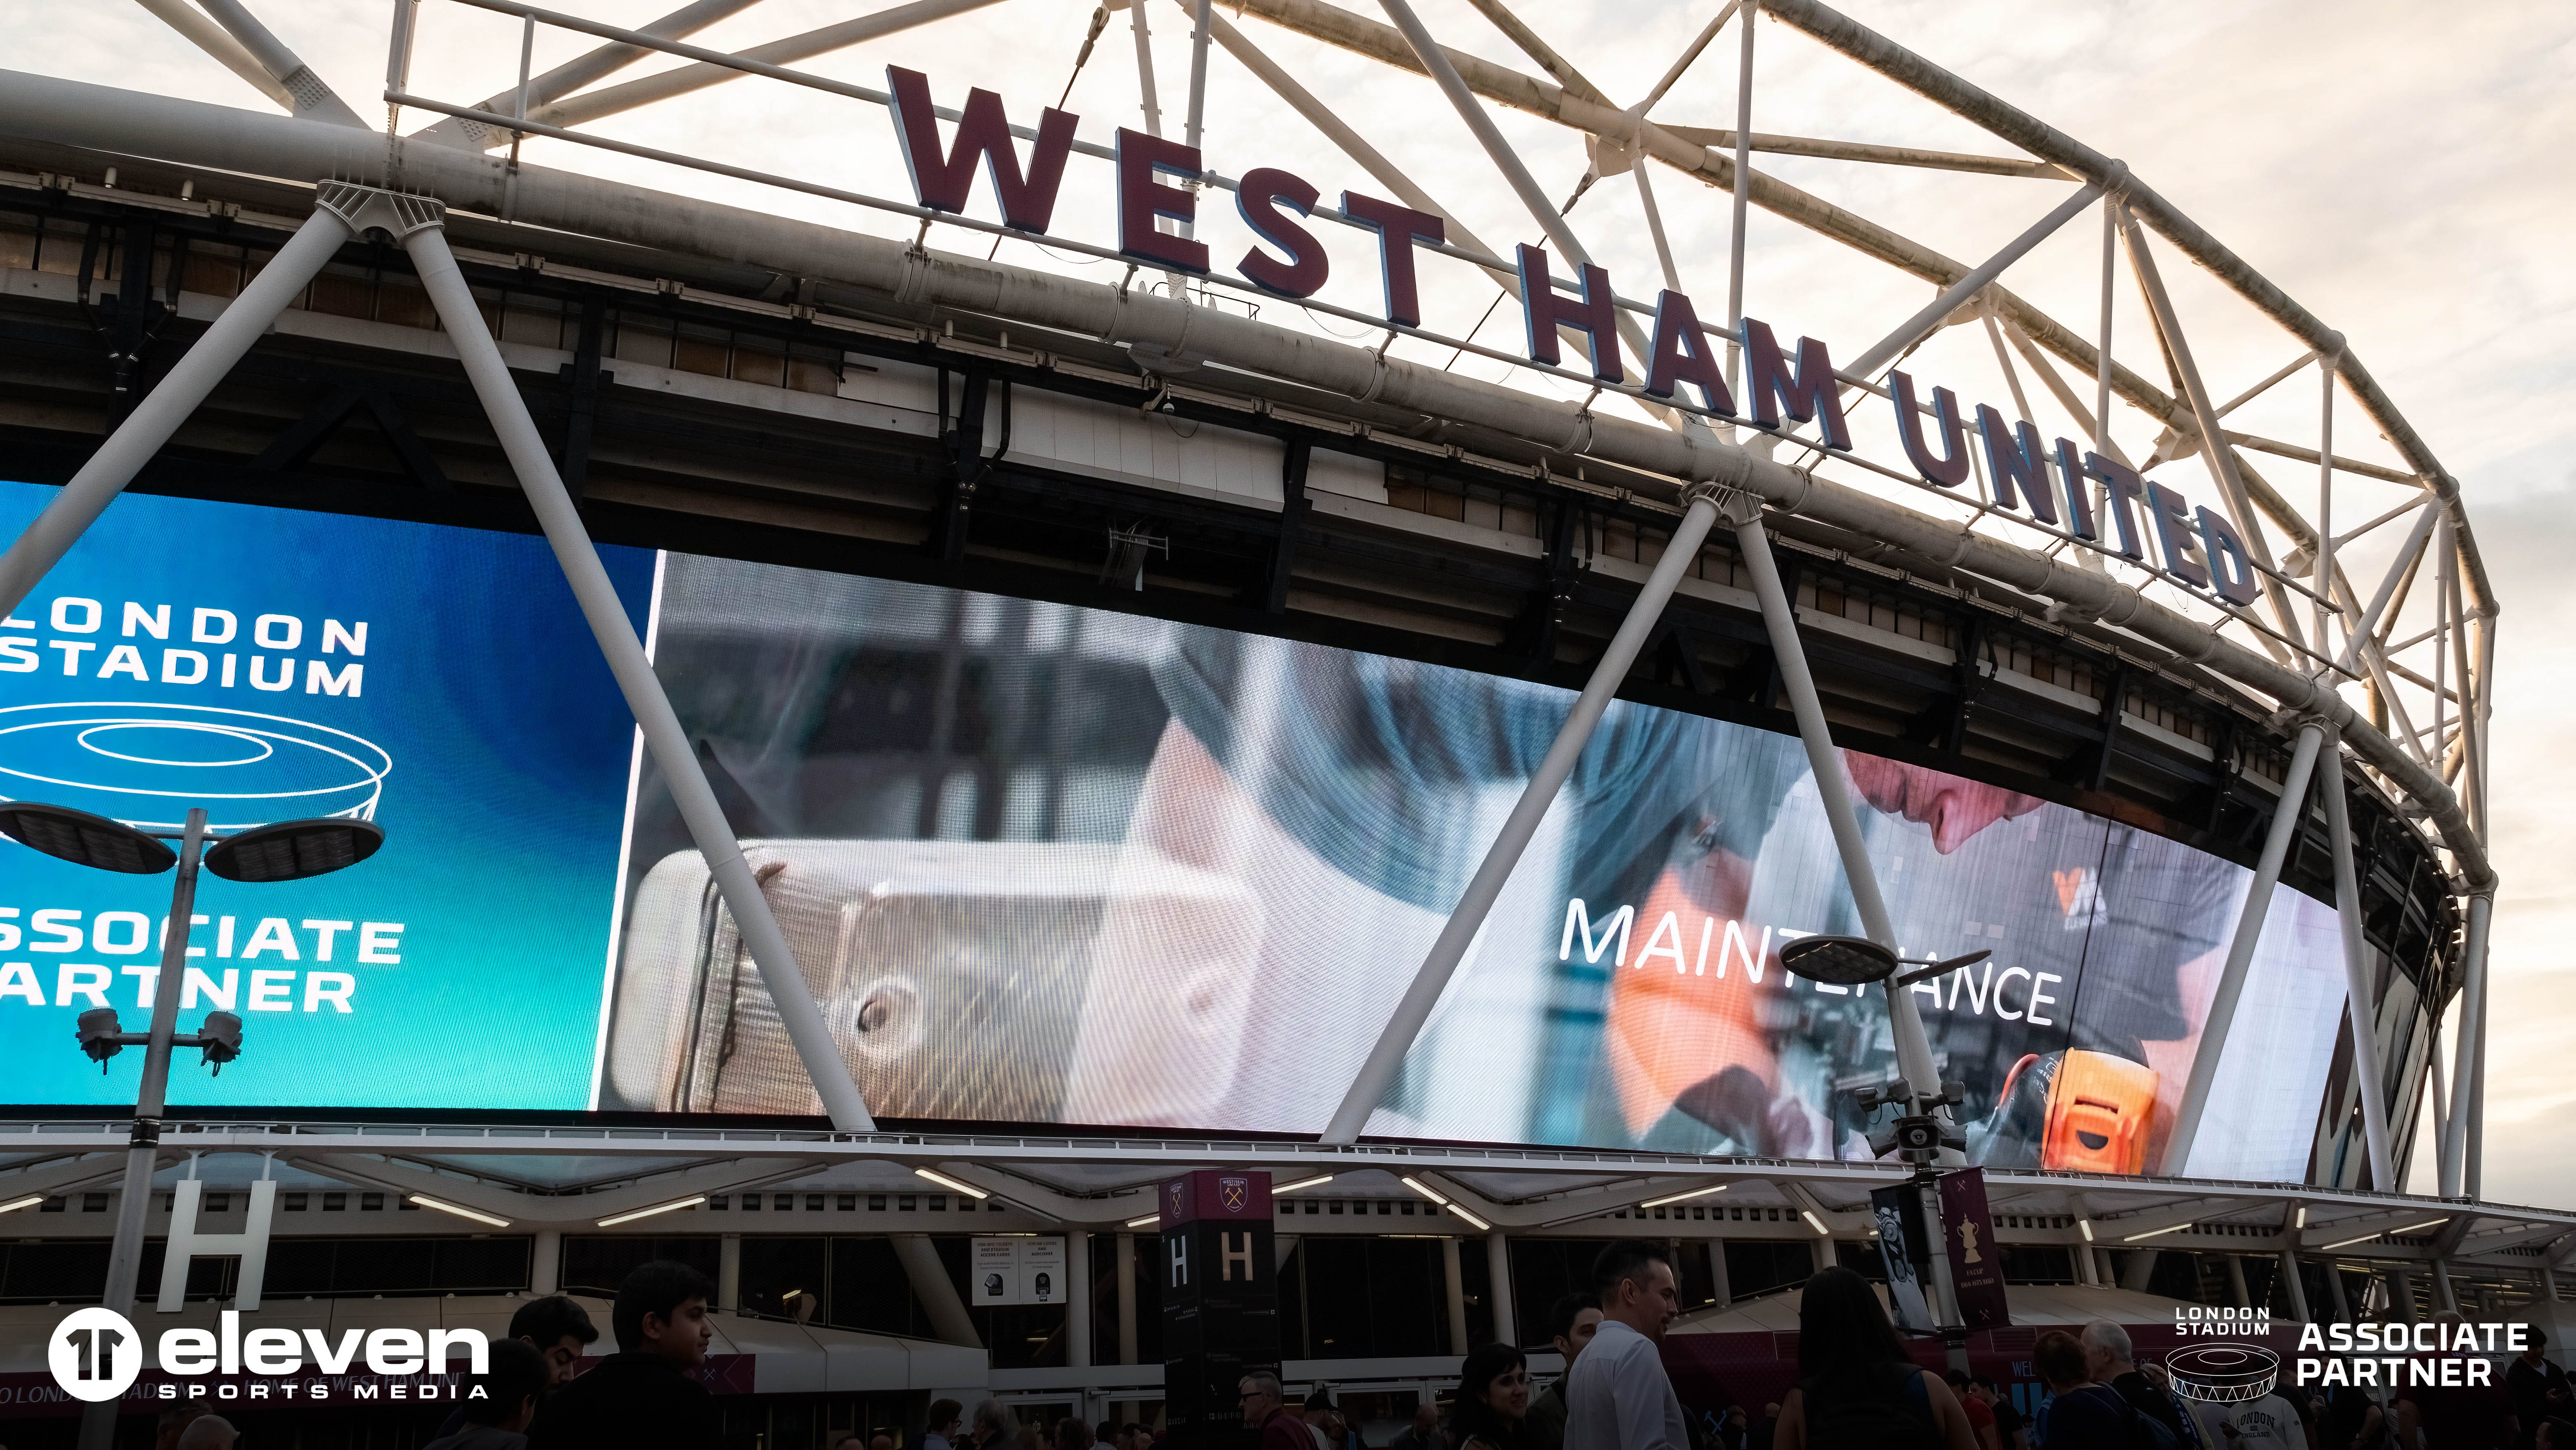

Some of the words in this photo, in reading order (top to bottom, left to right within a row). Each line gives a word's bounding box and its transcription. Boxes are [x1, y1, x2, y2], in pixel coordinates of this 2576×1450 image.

[886, 64, 1445, 328] WEST
[1516, 242, 1852, 452] HAM
[1888, 368, 2256, 607] UNITED
[0, 636, 363, 697] STADIUM
[1559, 898, 2062, 1026] MAINTANCE
[157, 1180, 276, 1312] H
[1171, 1235, 1187, 1288] H
[1222, 1232, 1254, 1281] H
[16, 1386, 84, 1403] LOND
[332, 1374, 381, 1391] WEST
[429, 1372, 466, 1387] UNI
[2012, 1361, 2037, 1377] WEL
[2237, 1412, 2275, 1429] LONDON
